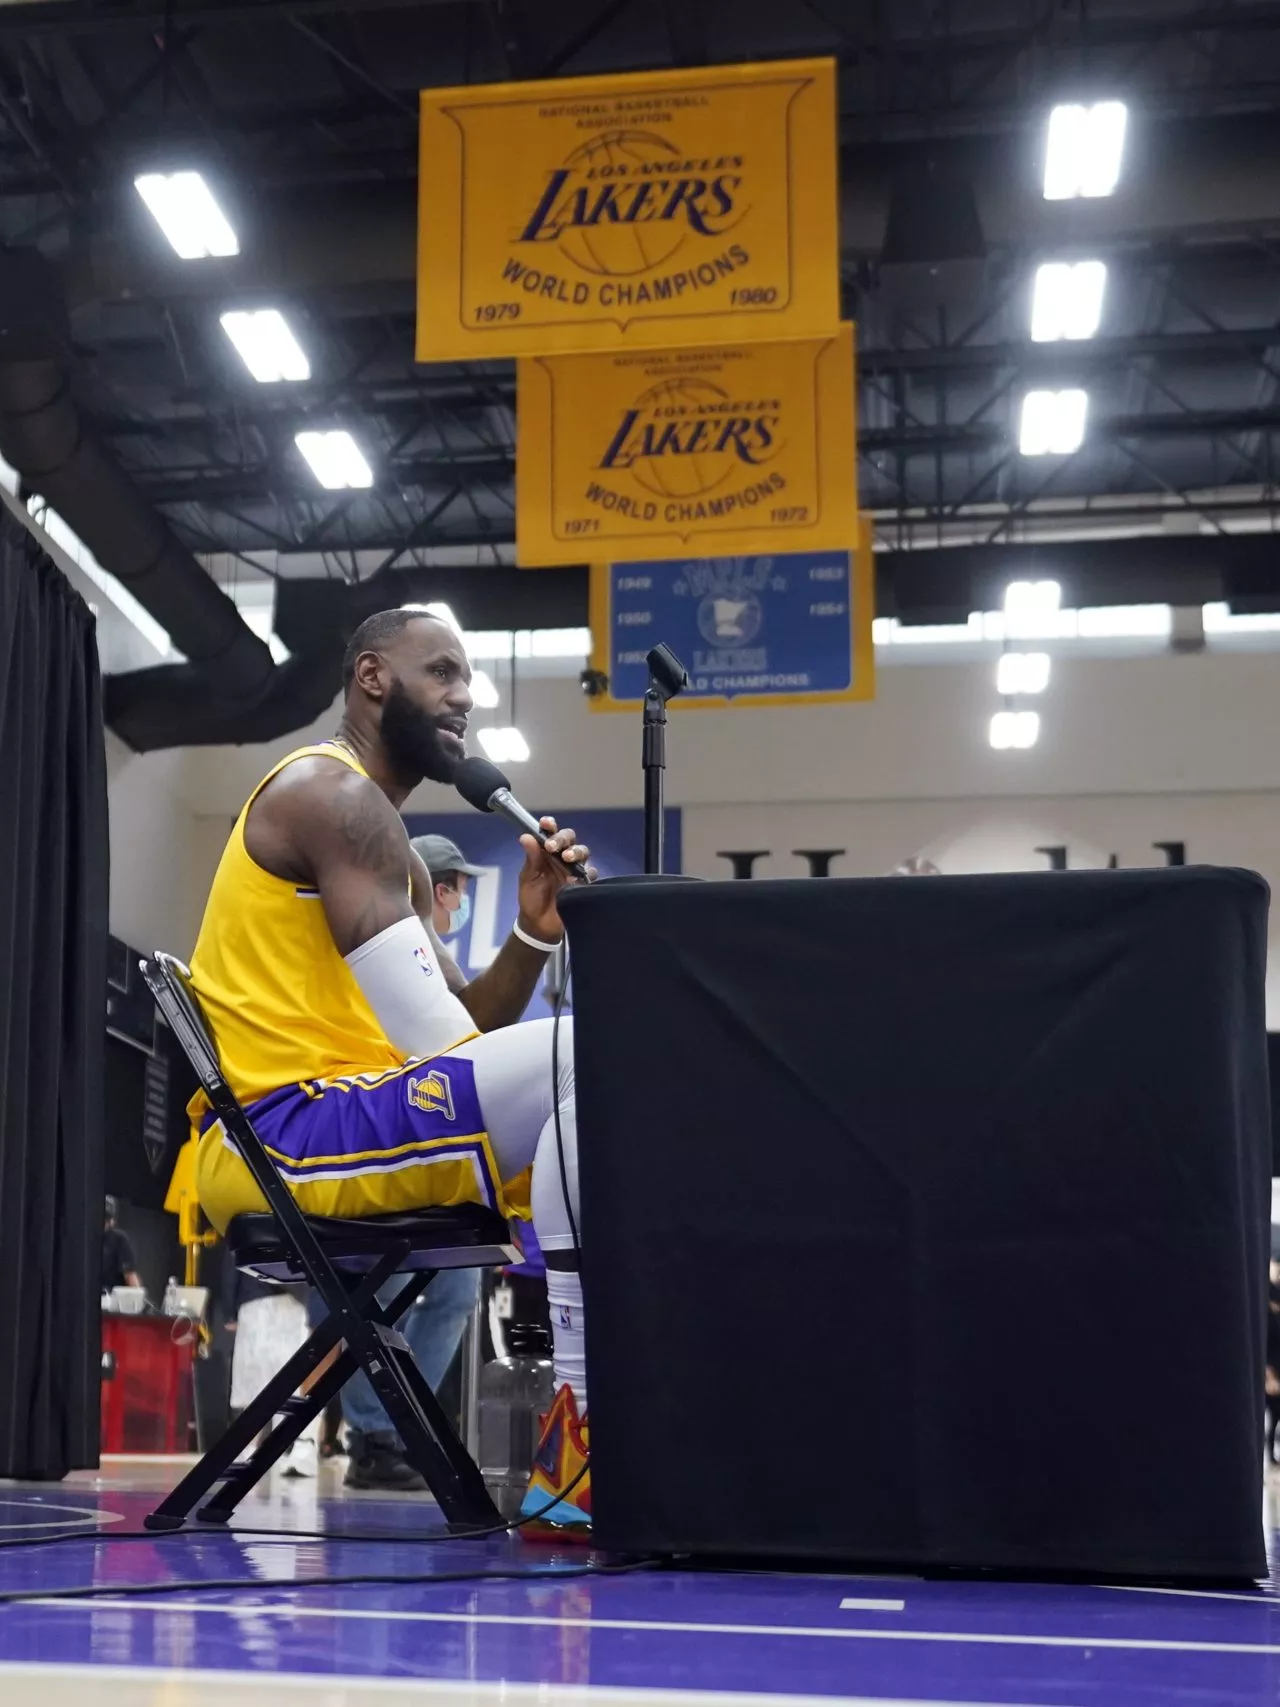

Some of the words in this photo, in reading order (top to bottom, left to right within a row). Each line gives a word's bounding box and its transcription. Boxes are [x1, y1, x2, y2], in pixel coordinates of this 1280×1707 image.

[587, 164, 629, 180] LOS
[634, 154, 745, 176] ANGELES
[513, 169, 749, 241] LAKERS
[502, 257, 590, 305] WORLD
[599, 244, 749, 307] CHAMPIONS
[474, 303, 521, 323] 1979
[730, 287, 778, 306] 1980
[595, 409, 784, 469] LAKERS
[585, 481, 658, 522] WORLD
[664, 471, 787, 523] CHAMPIONS
[564, 519, 600, 534] 1971
